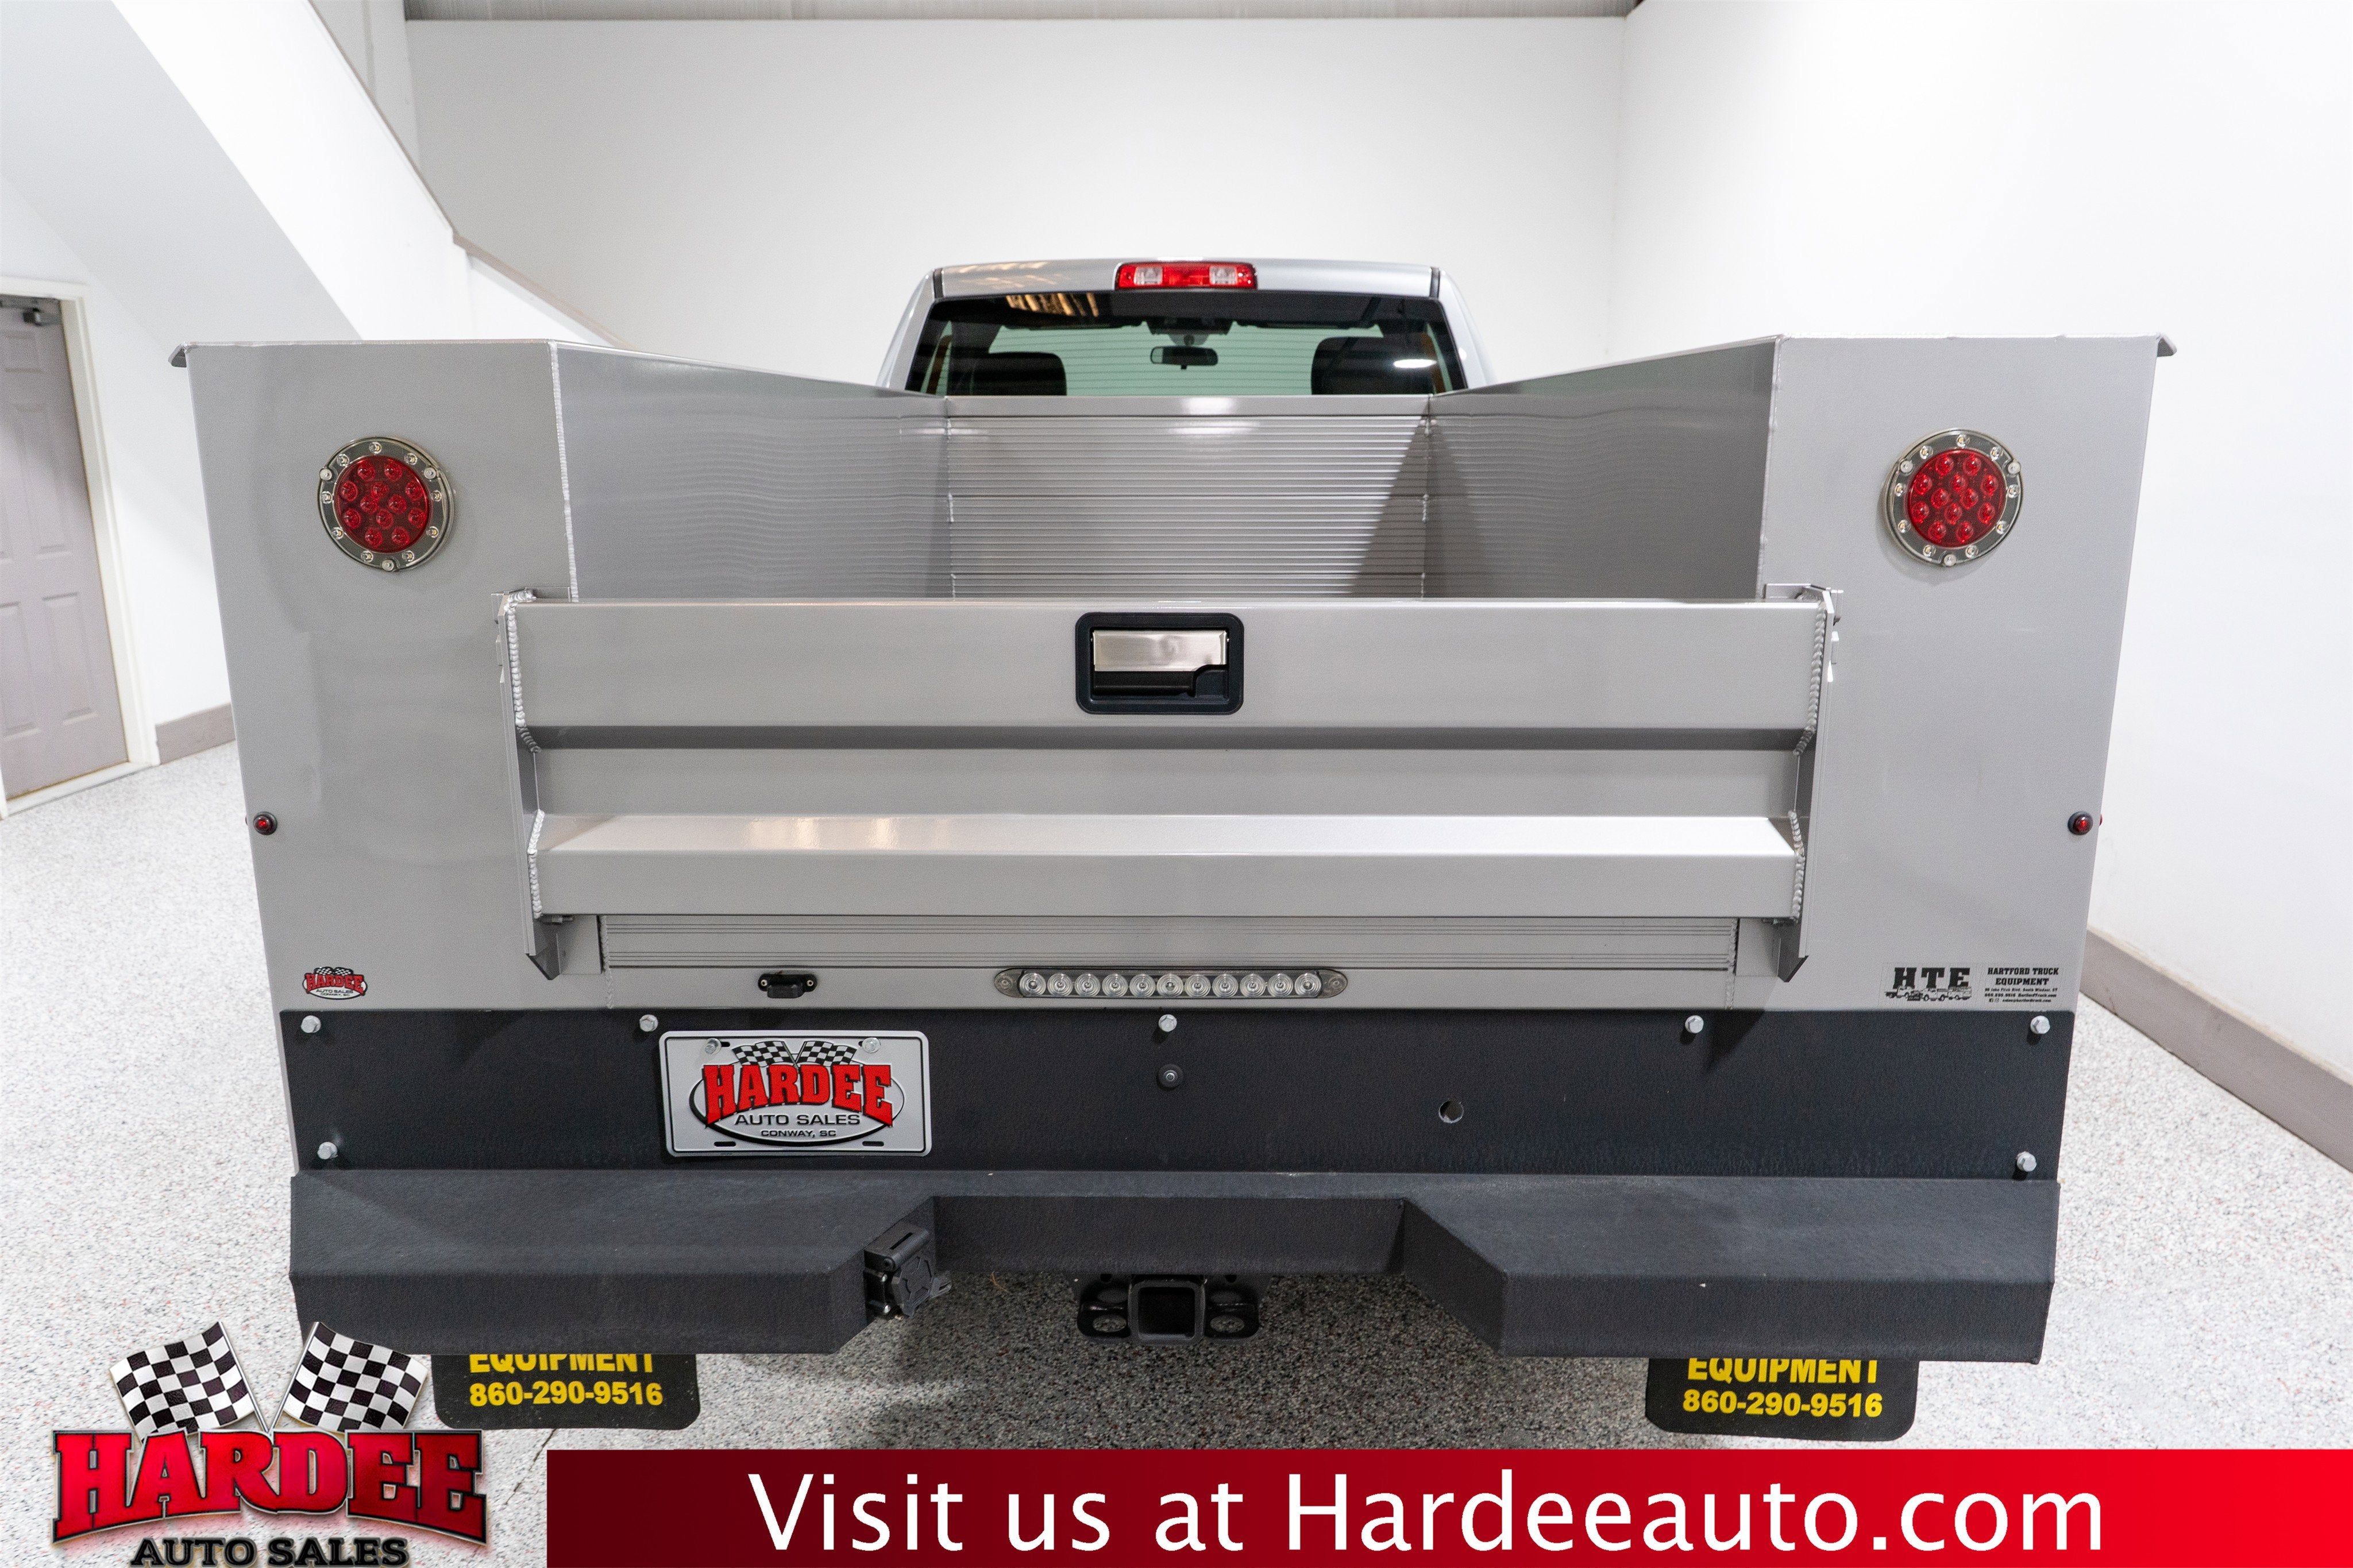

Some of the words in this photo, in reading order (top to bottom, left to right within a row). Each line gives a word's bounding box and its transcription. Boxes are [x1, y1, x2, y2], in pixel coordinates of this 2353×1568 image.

[1892, 967, 1971, 989] HTE
[1987, 967, 2030, 975] HARTFORD
[2032, 967, 2059, 975] TRUCK
[1995, 978, 2050, 986] EQUIPMENT
[304, 973, 365, 995] HARDEE
[701, 1064, 893, 1127] HARDEE
[735, 1114, 790, 1126] AUTO
[796, 1114, 861, 1126] SALES
[761, 1130, 816, 1138] CONWAY,
[469, 1380, 664, 1407] 860-290-9516
[1683, 1389, 1884, 1418] 860-290-9516
